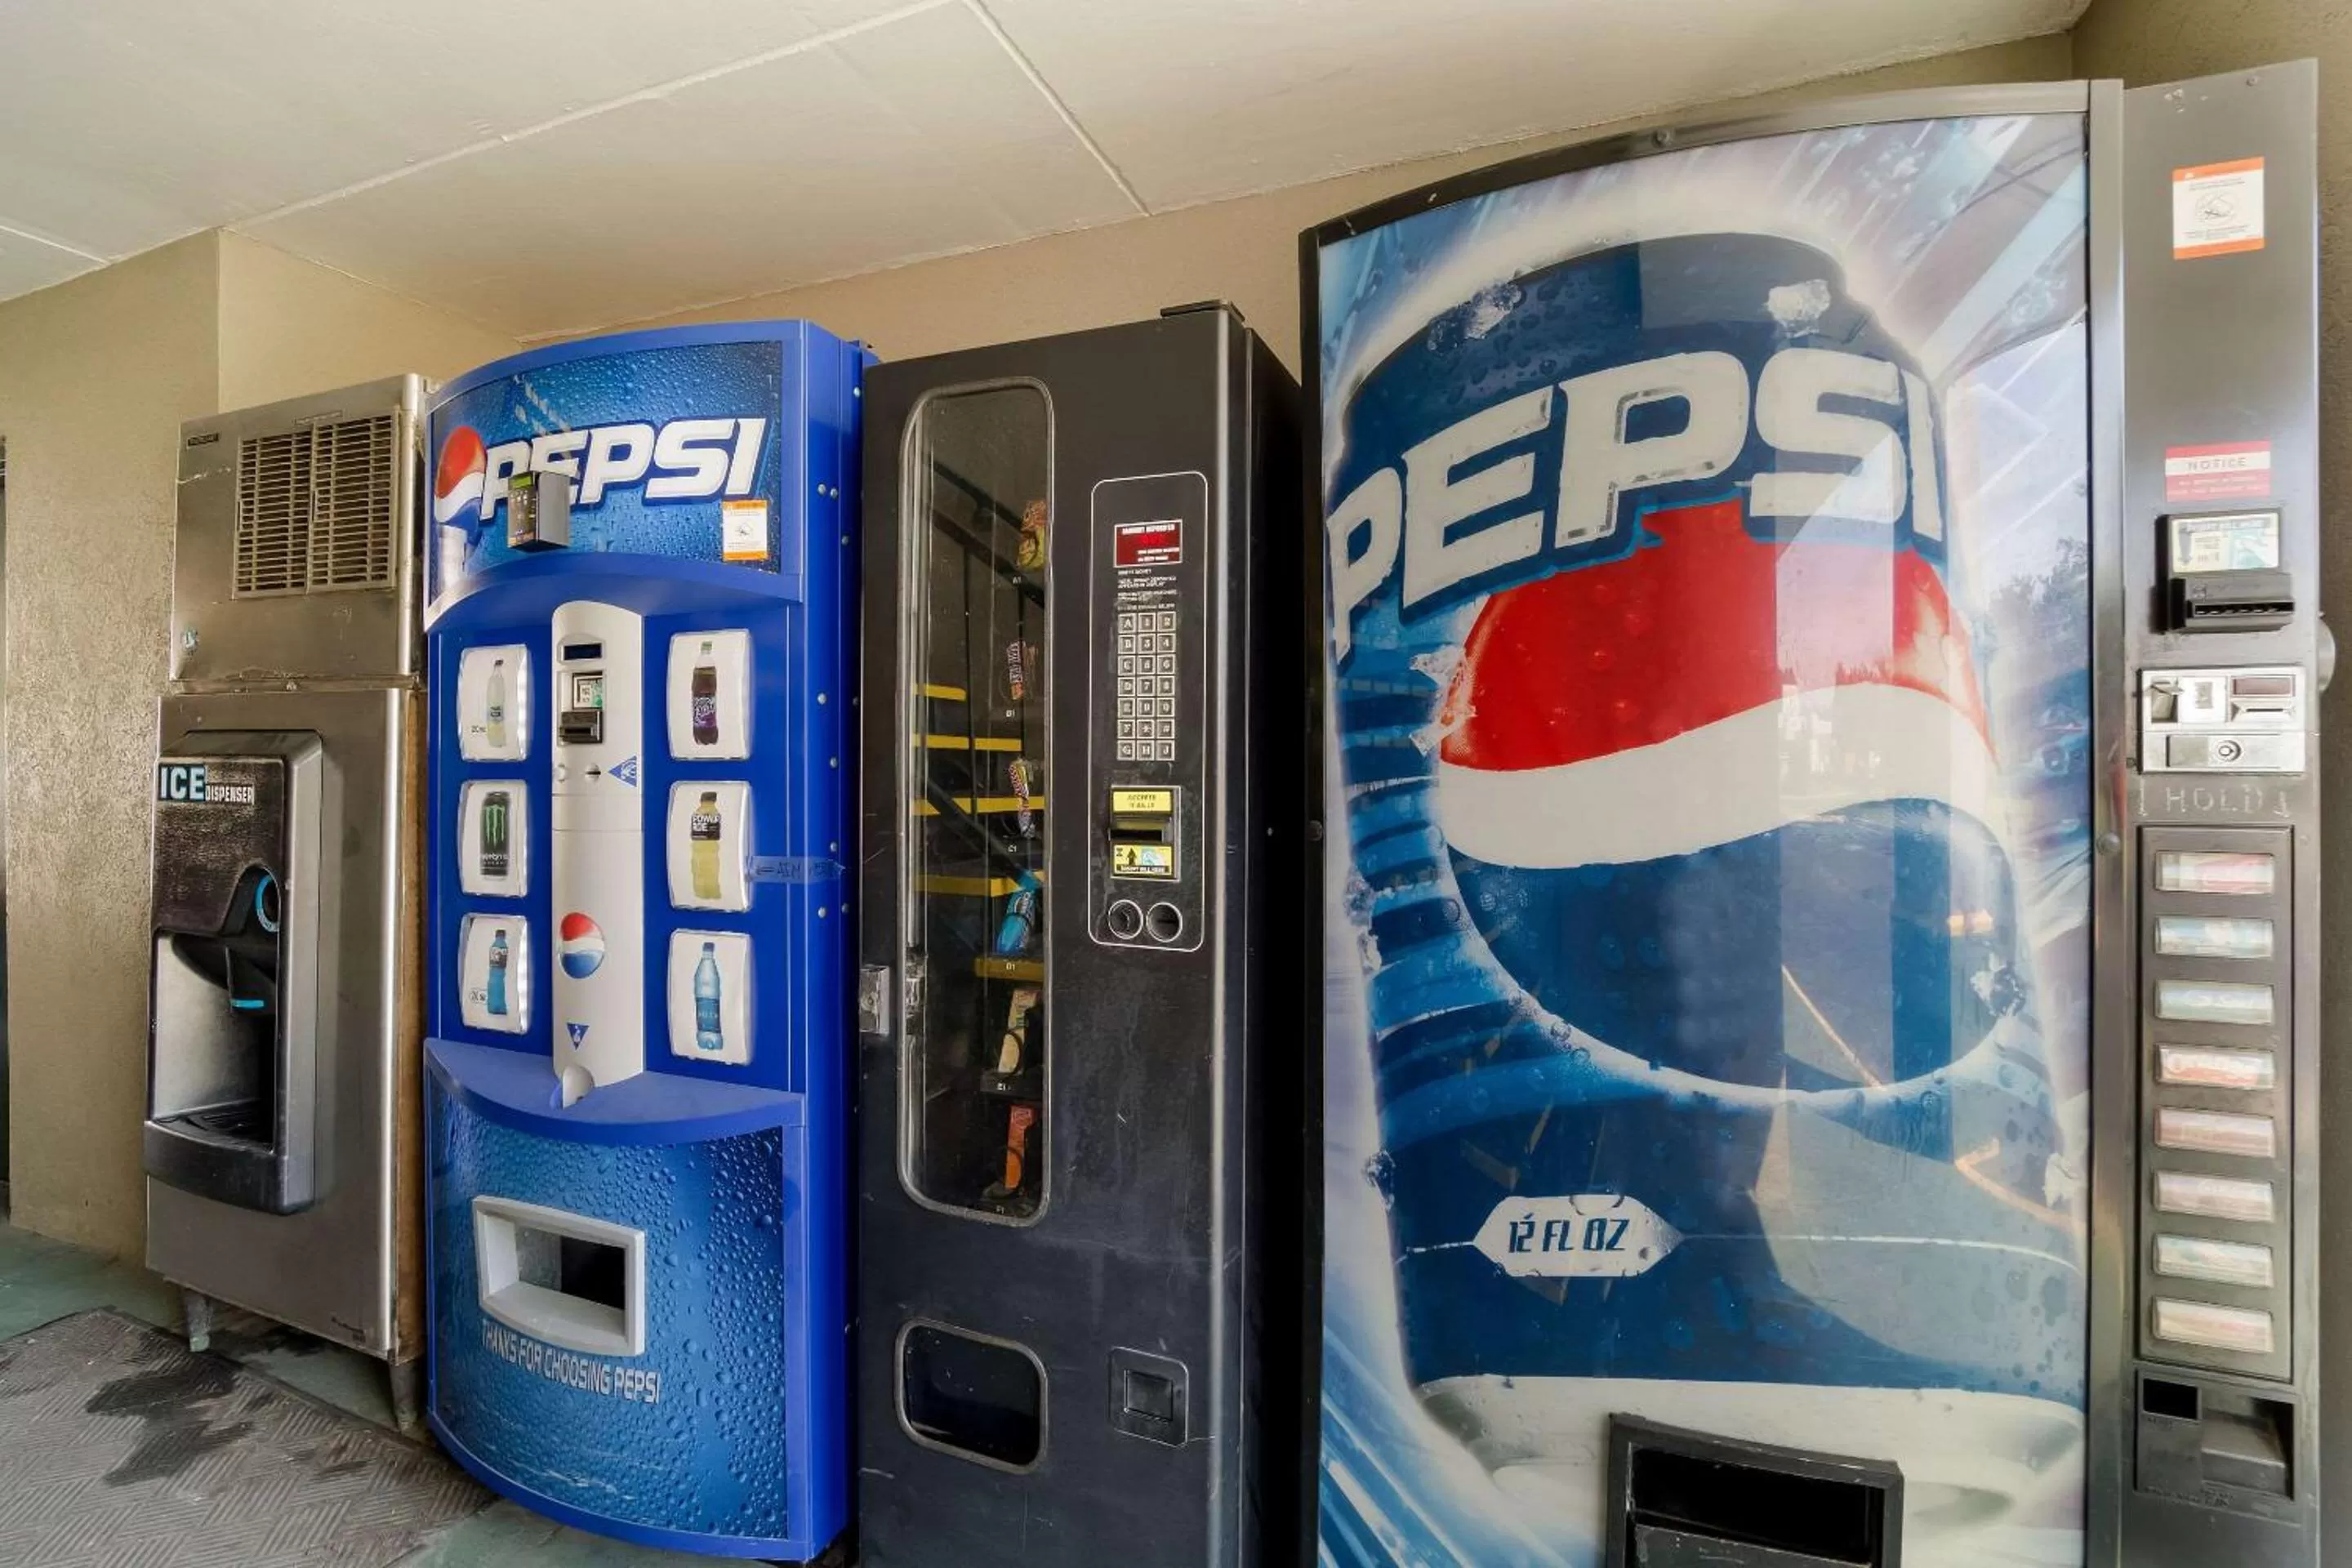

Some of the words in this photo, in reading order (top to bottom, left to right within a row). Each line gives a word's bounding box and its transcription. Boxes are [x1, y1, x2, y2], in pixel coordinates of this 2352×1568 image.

[480, 417, 767, 519] PEPSI
[2188, 457, 2247, 471] NOTICE
[1325, 348, 1948, 664] PEPSI
[160, 766, 206, 800] ICE
[206, 784, 256, 804] DISPENSER
[1508, 1215, 1535, 1254] 12
[1542, 1219, 1574, 1252] FL
[1582, 1217, 1630, 1252] OZ
[518, 1339, 541, 1374] FOR
[545, 1348, 611, 1396] CHOOSING
[614, 1365, 662, 1405] PEPSI
